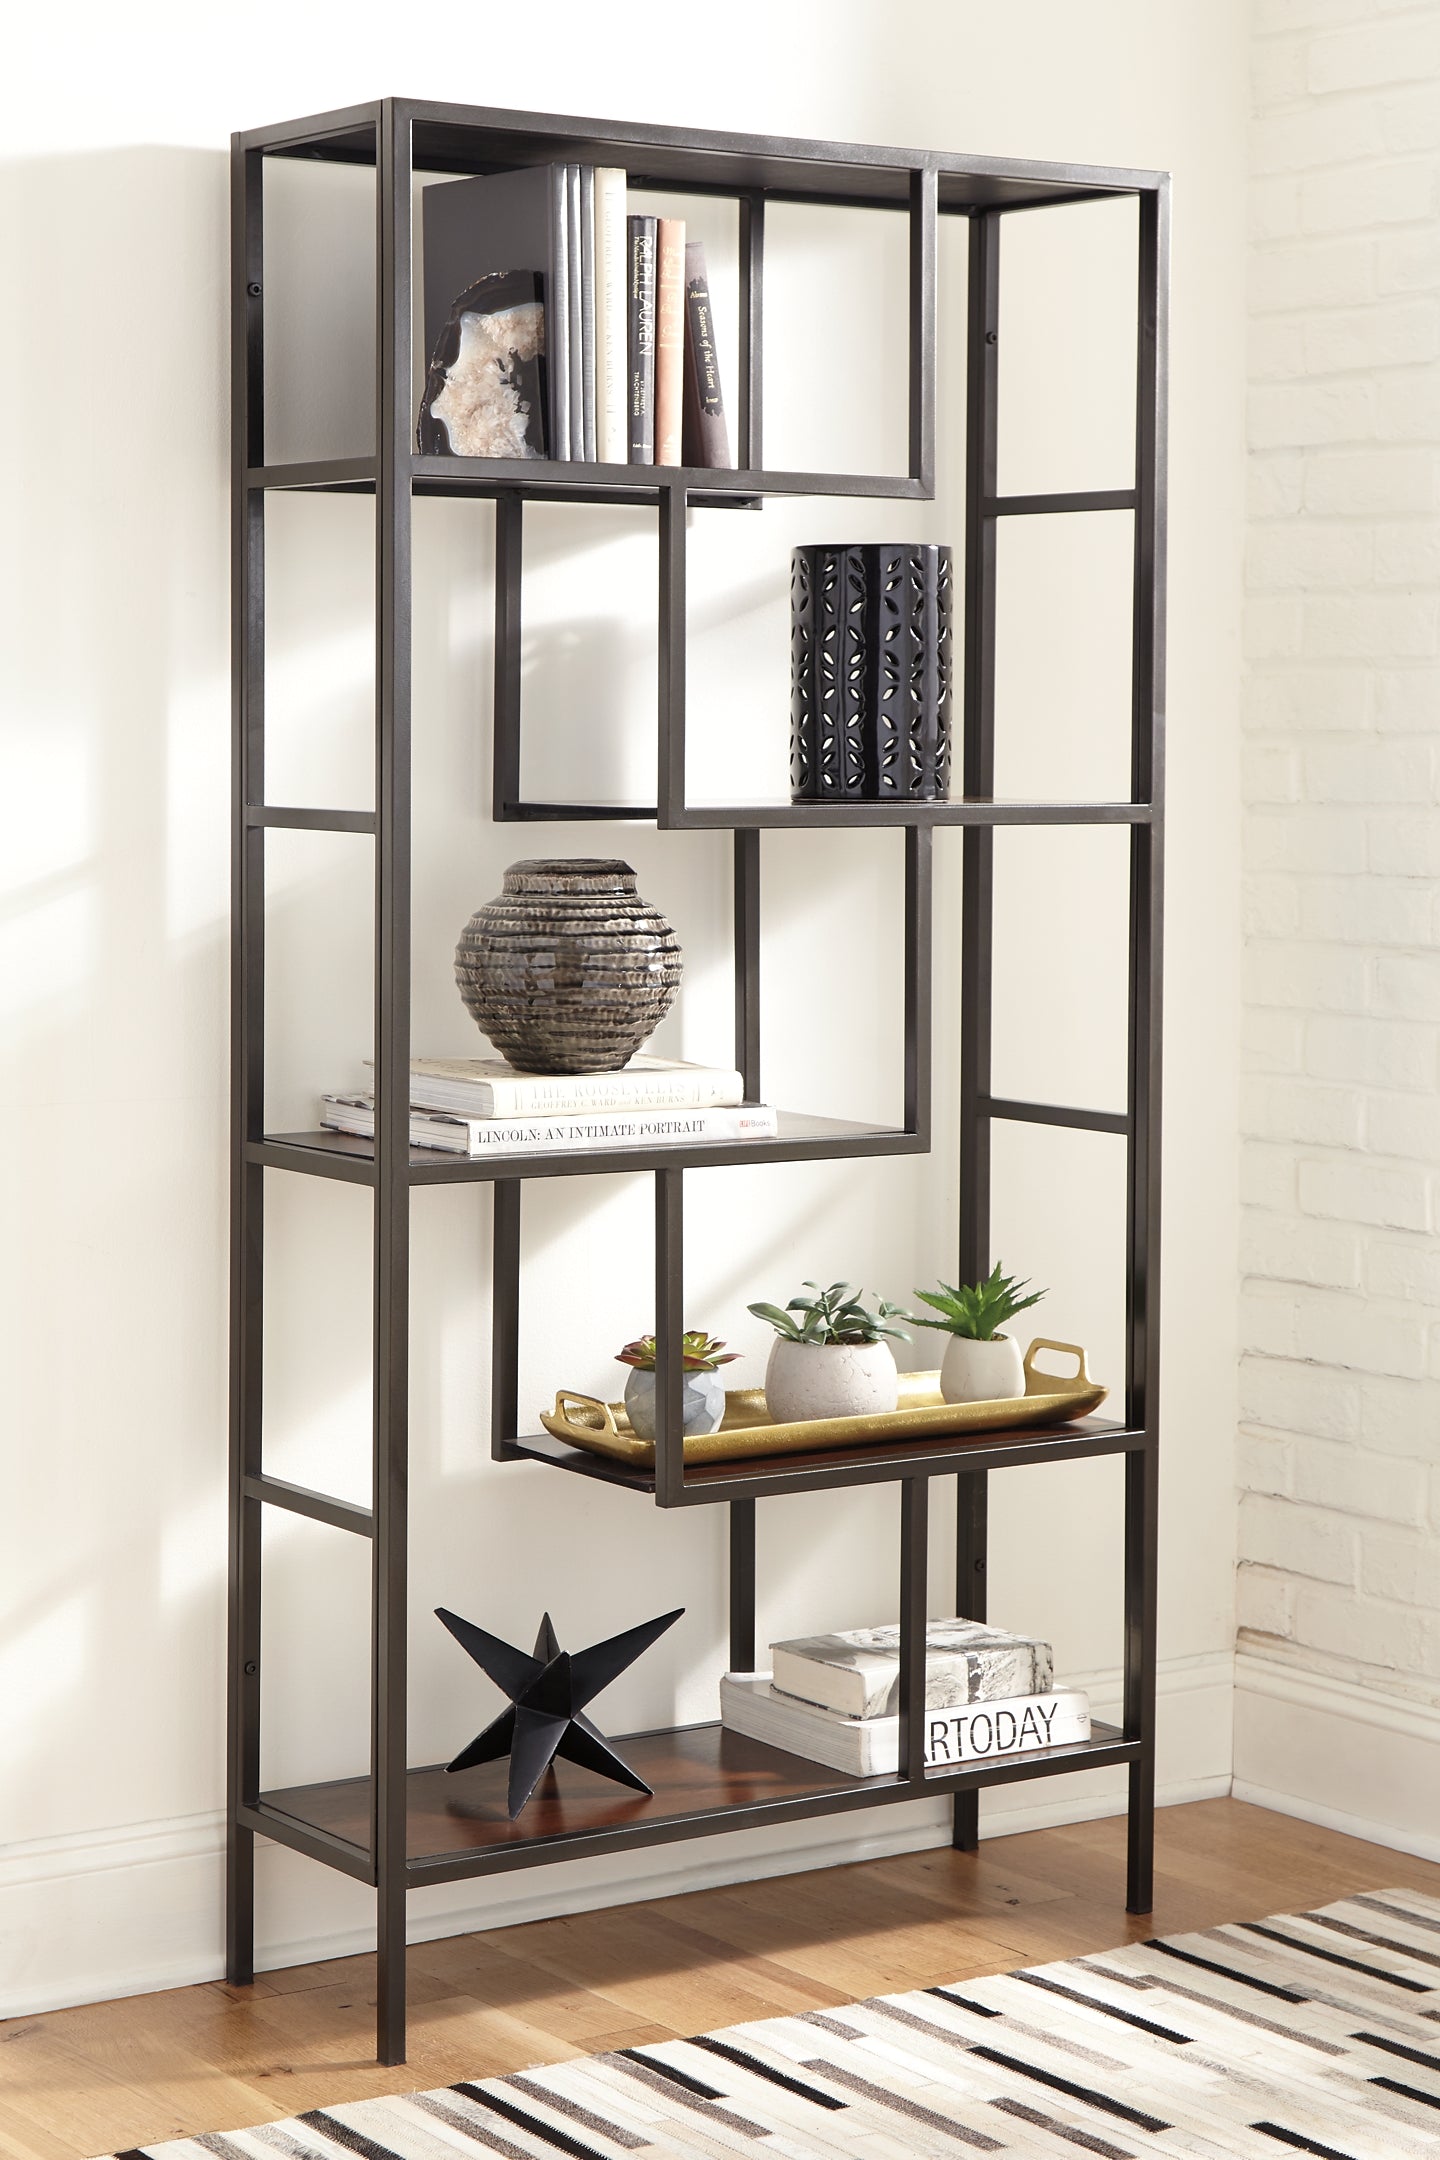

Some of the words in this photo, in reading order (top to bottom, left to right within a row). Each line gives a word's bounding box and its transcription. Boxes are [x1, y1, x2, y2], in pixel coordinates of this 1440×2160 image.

[638, 235, 653, 285] RALPH
[638, 290, 653, 356] LAUREN
[697, 306, 708, 337] Seasons
[699, 339, 713, 349] of
[703, 350, 713, 363] the
[705, 365, 715, 388] Heart
[532, 1084, 566, 1100] THE
[573, 1081, 686, 1098] ROOSEVELTS
[530, 1100, 579, 1110] GEOFFREY
[590, 1098, 617, 1107] WARD
[633, 1096, 655, 1106] KEN
[655, 1095, 686, 1104] BURNS
[477, 1128, 541, 1143] LINCOLN:
[544, 1126, 565, 1140] AN
[569, 1123, 637, 1139] INTIMATE
[639, 1120, 706, 1135] PORTRAIT
[924, 1702, 1058, 1762] RTODAY
